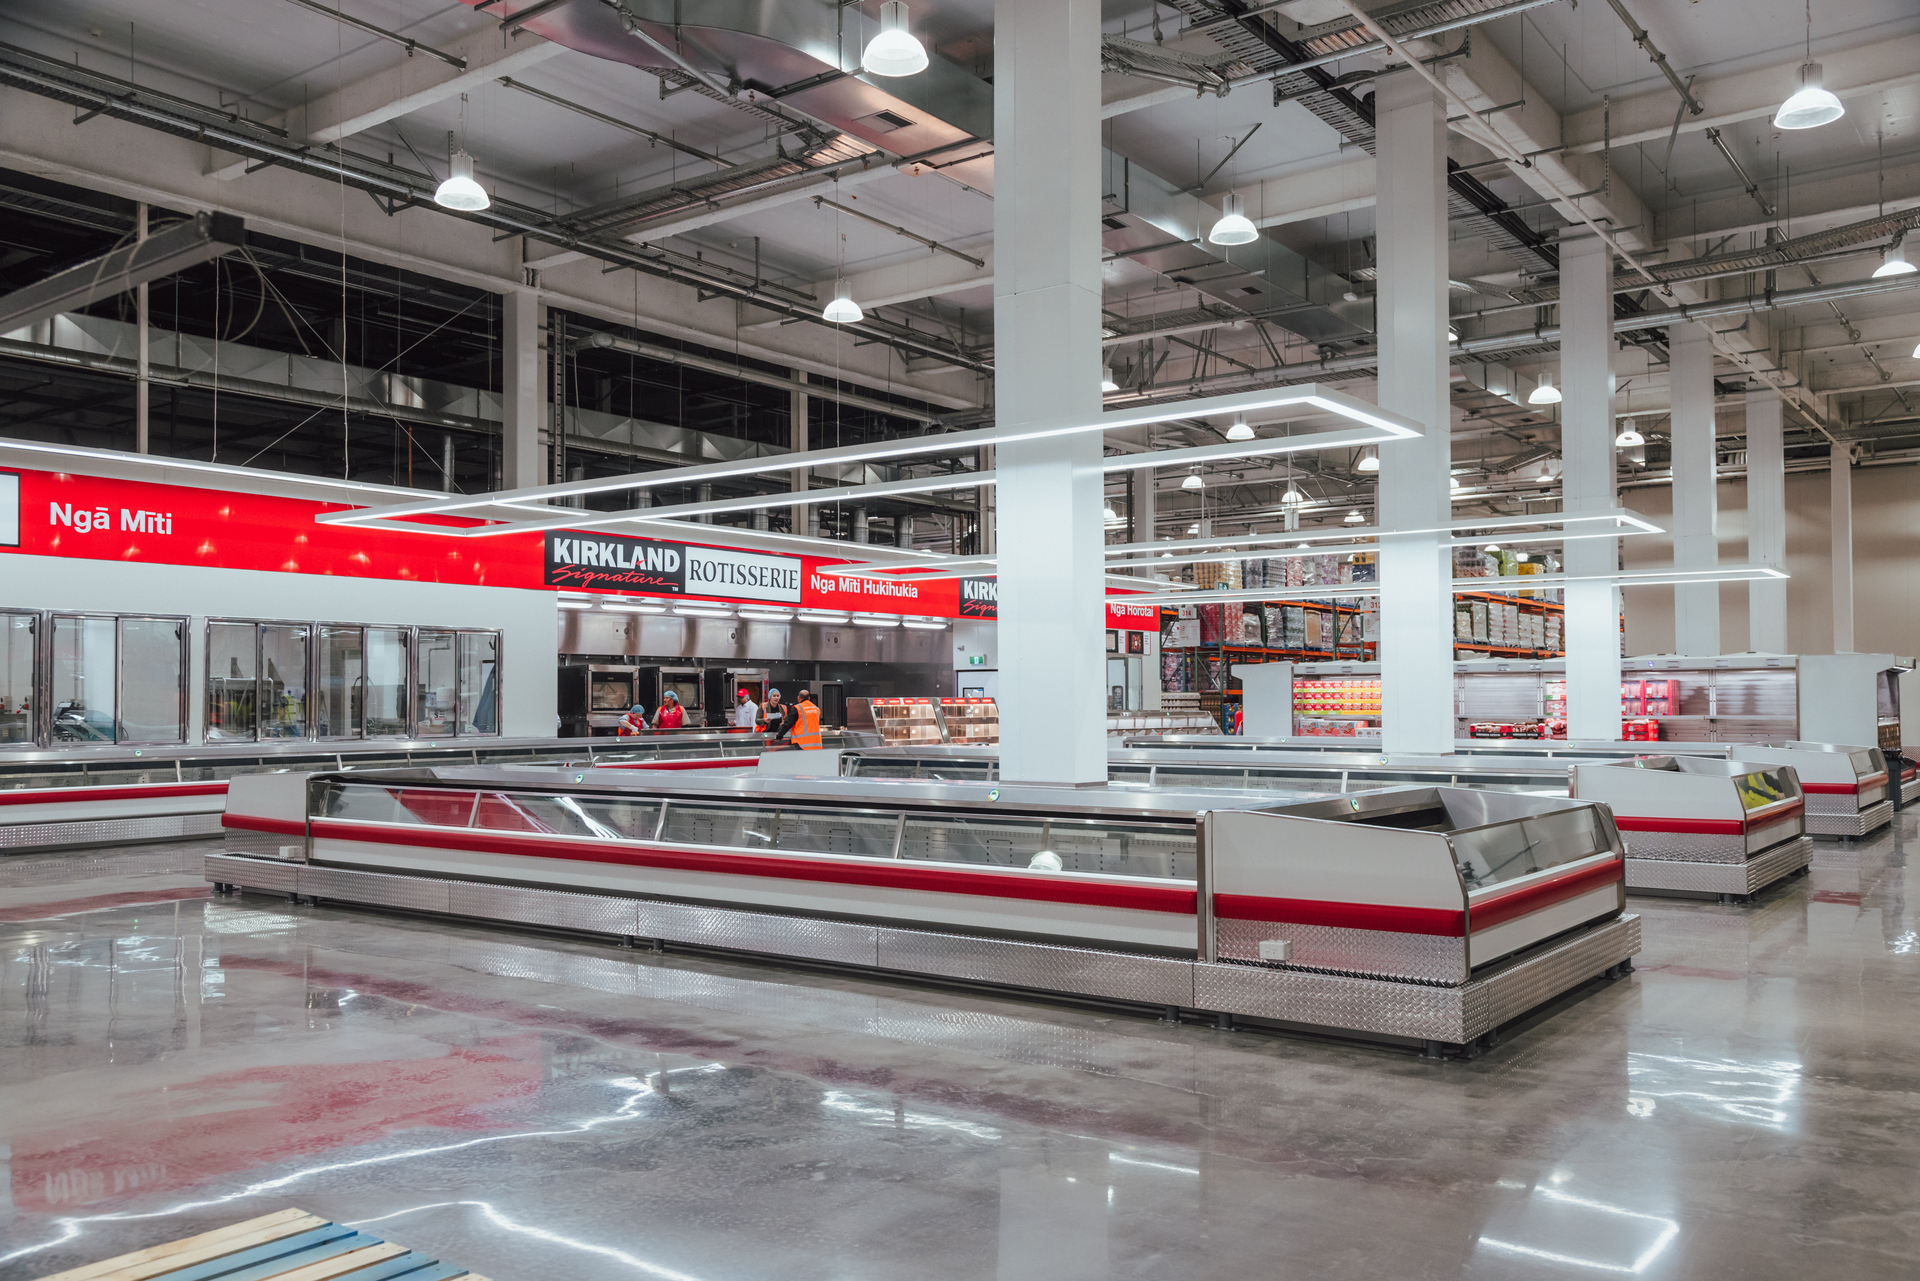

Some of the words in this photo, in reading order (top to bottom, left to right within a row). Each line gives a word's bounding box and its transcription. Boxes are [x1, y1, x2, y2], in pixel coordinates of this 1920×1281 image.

[50, 502, 110, 533] Ngā
[120, 508, 172, 535] Mīti
[553, 537, 680, 573] KIRKLAND
[552, 564, 679, 588] Signature
[689, 559, 798, 590] ROTISSERIE
[863, 579, 918, 598] Hukihukia
[1127, 604, 1154, 617] Horotai
[1181, 609, 1192, 617] 314
